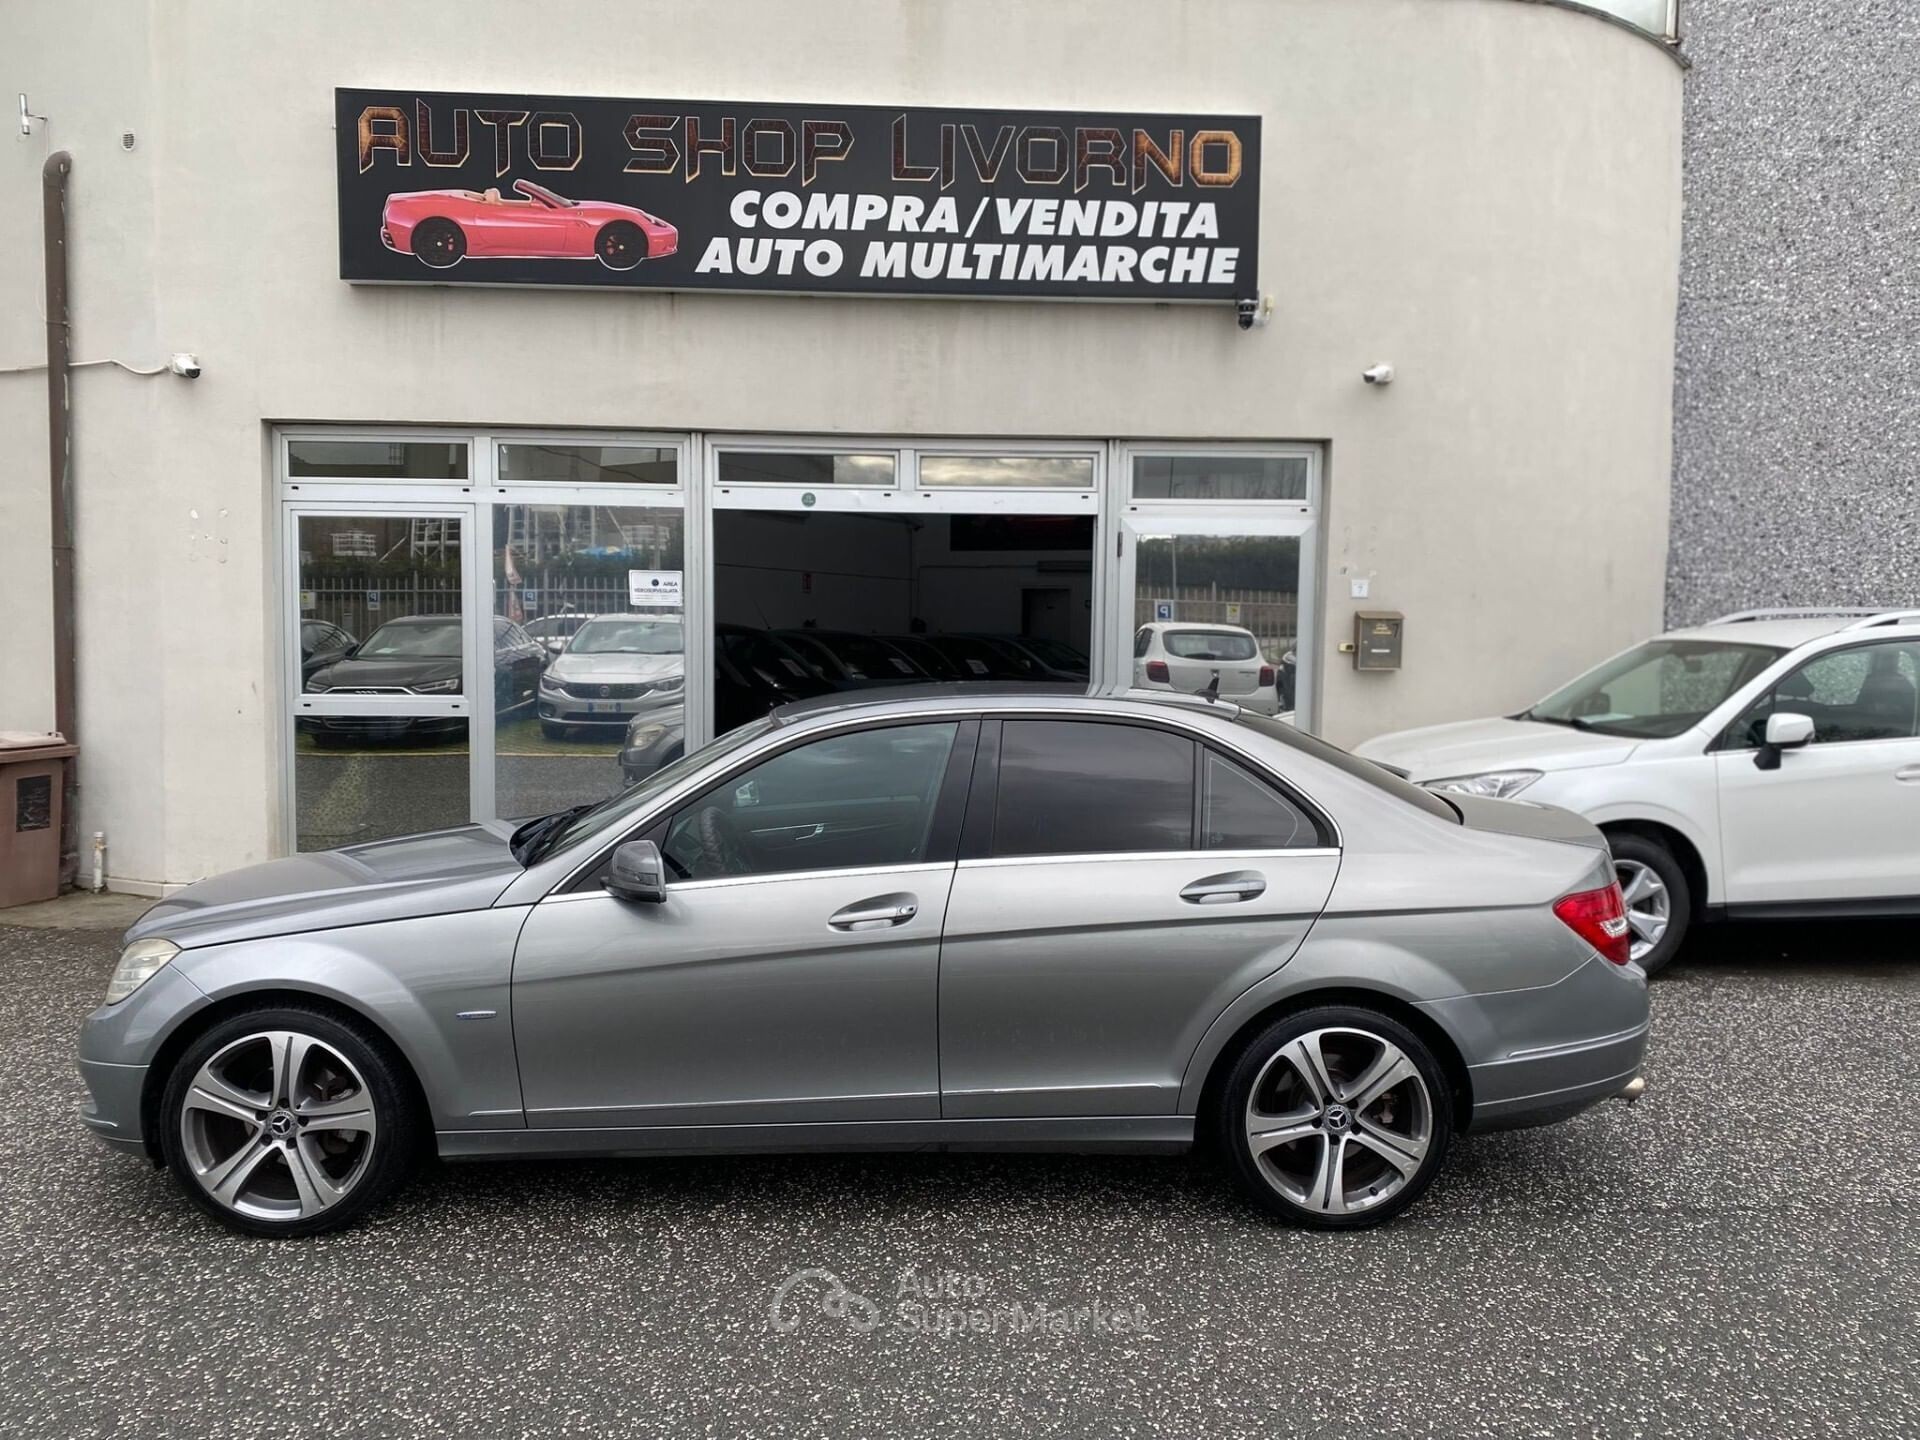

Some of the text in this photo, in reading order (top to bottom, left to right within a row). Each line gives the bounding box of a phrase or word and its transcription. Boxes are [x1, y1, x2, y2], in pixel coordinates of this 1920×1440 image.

[358, 97, 1243, 195] AUTO SHOP LIVORNO
[695, 236, 1241, 285] AUTO MULTIMARCHE
